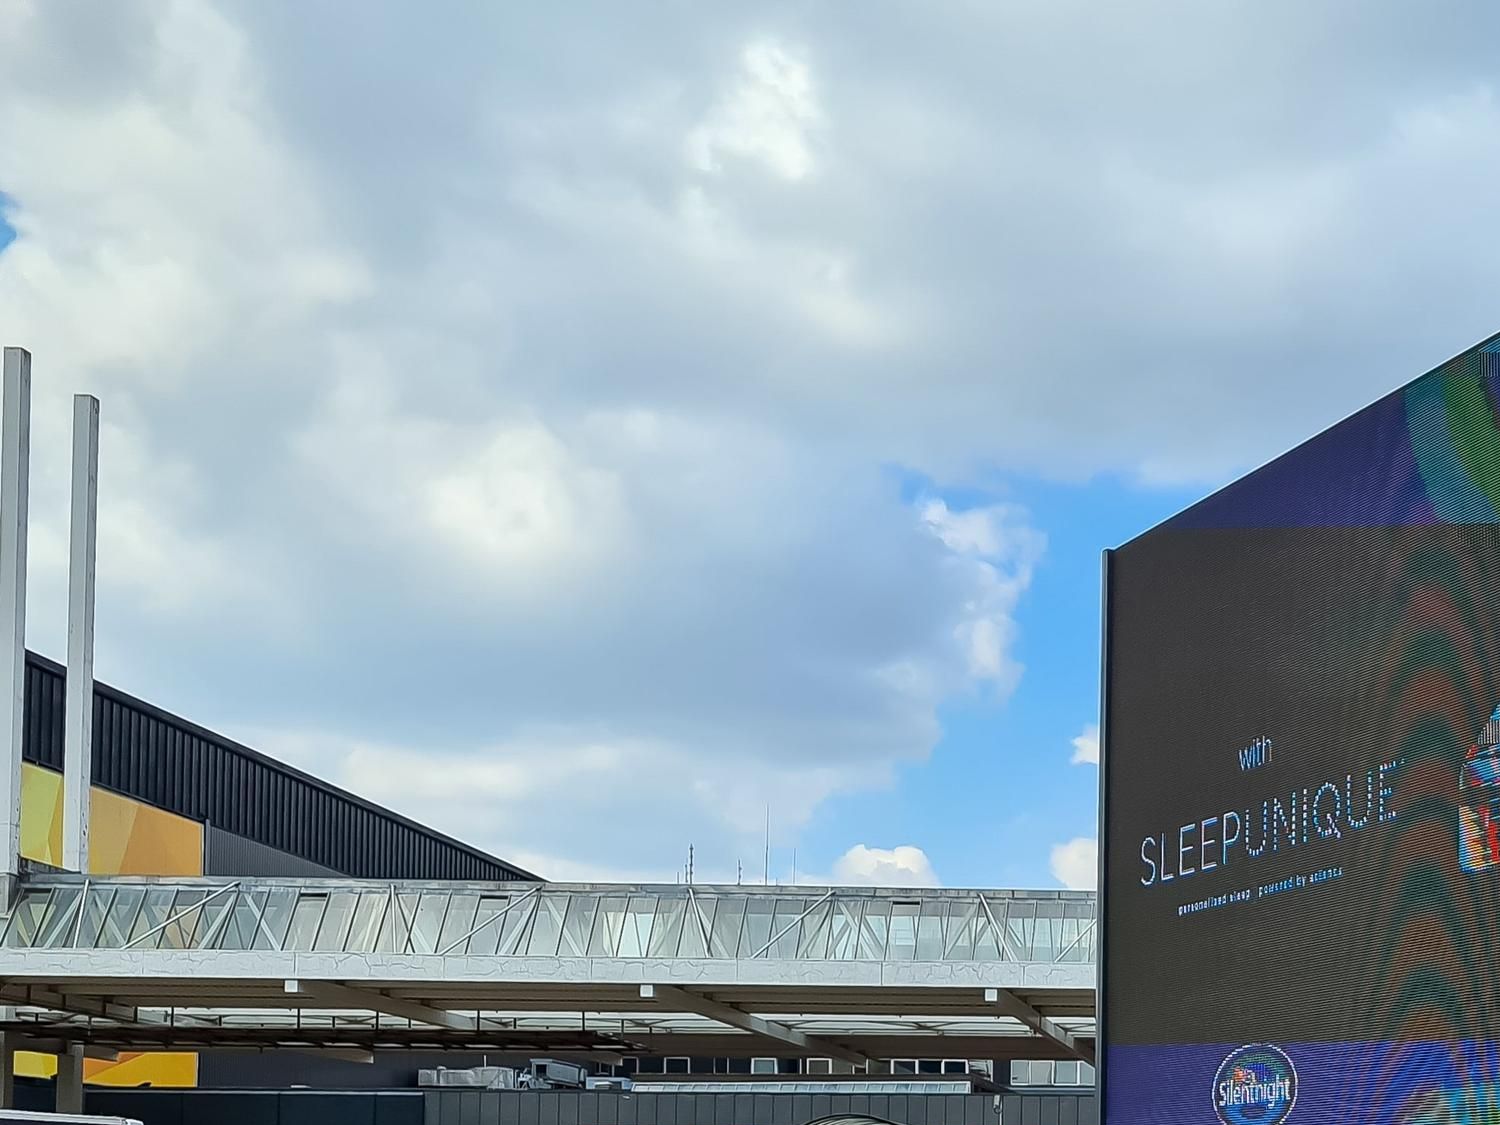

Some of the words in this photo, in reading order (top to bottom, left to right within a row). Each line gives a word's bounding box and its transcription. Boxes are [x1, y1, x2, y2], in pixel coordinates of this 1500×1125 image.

[1239, 735, 1272, 771] with
[1140, 758, 1405, 886] SLEEPUNIQUE
[1296, 874, 1306, 887] by
[1219, 1074, 1291, 1110] Silentnight
